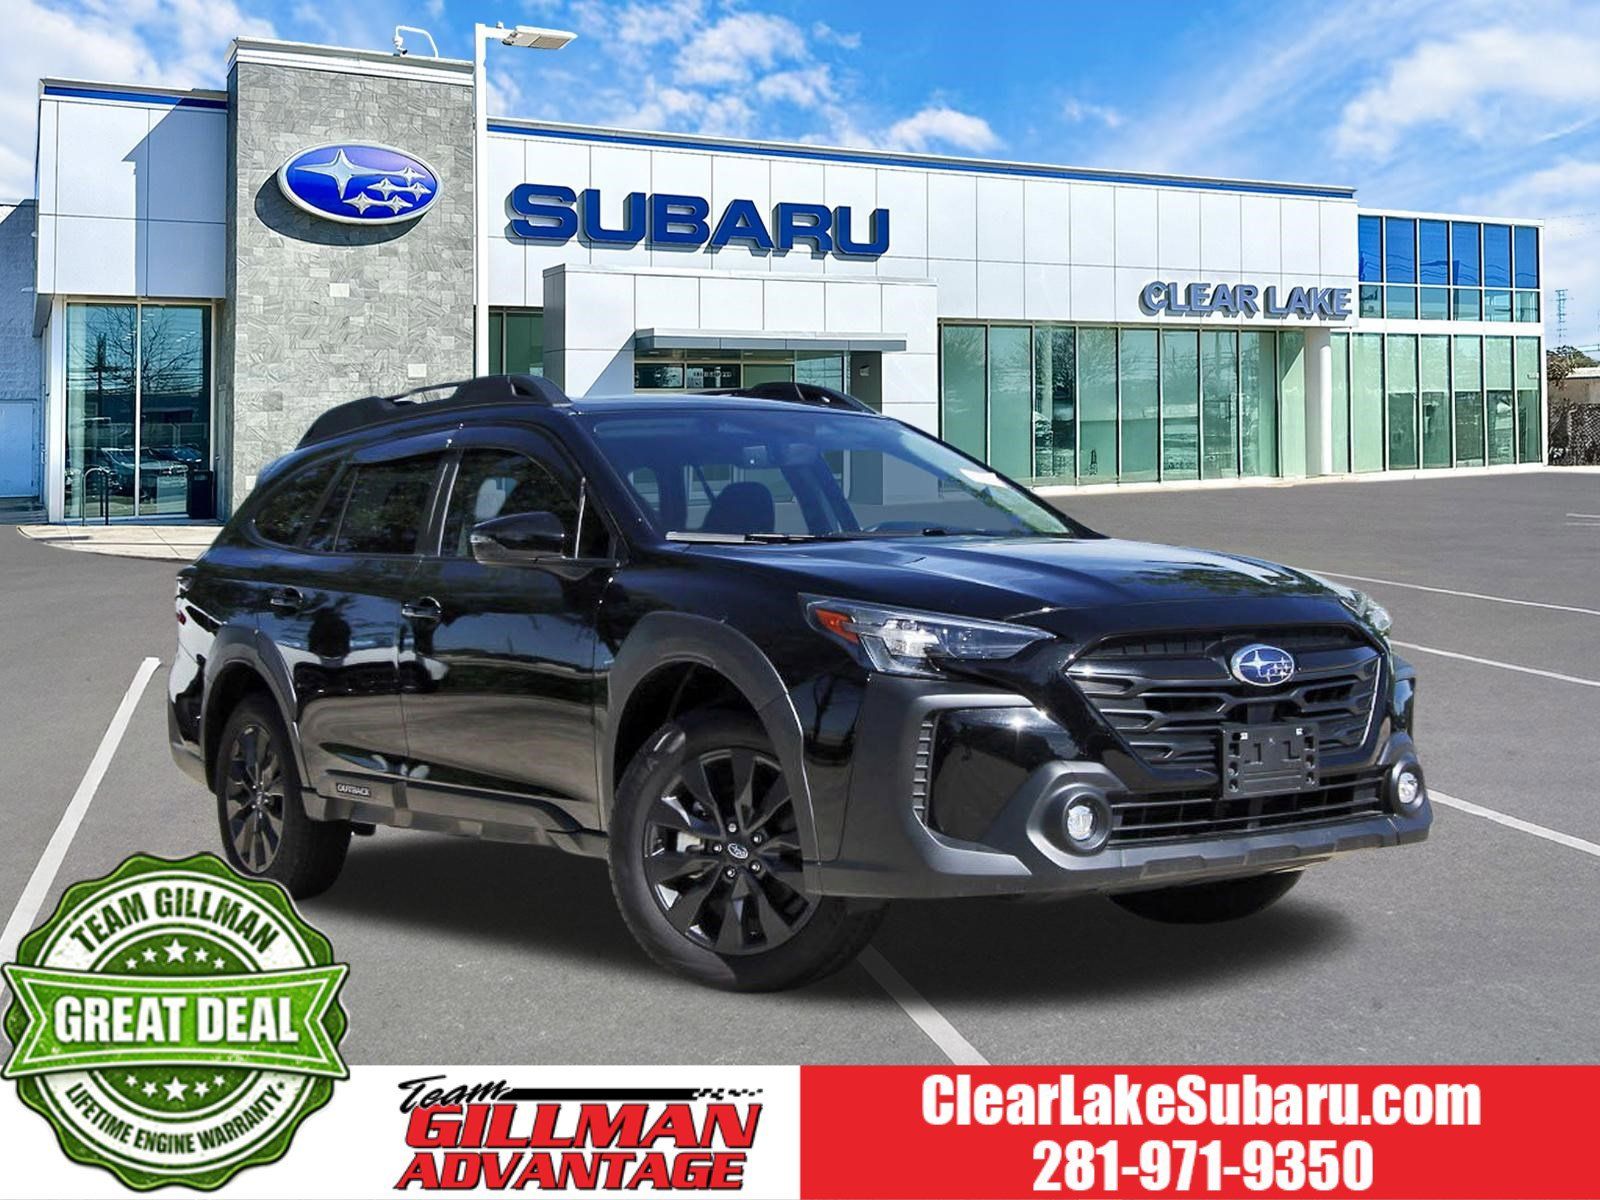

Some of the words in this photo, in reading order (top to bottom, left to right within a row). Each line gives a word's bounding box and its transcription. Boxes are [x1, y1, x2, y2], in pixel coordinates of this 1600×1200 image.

[506, 183, 889, 259] SUBARU
[1139, 280, 1260, 318] CLEAR
[1264, 285, 1353, 320] LAKE
